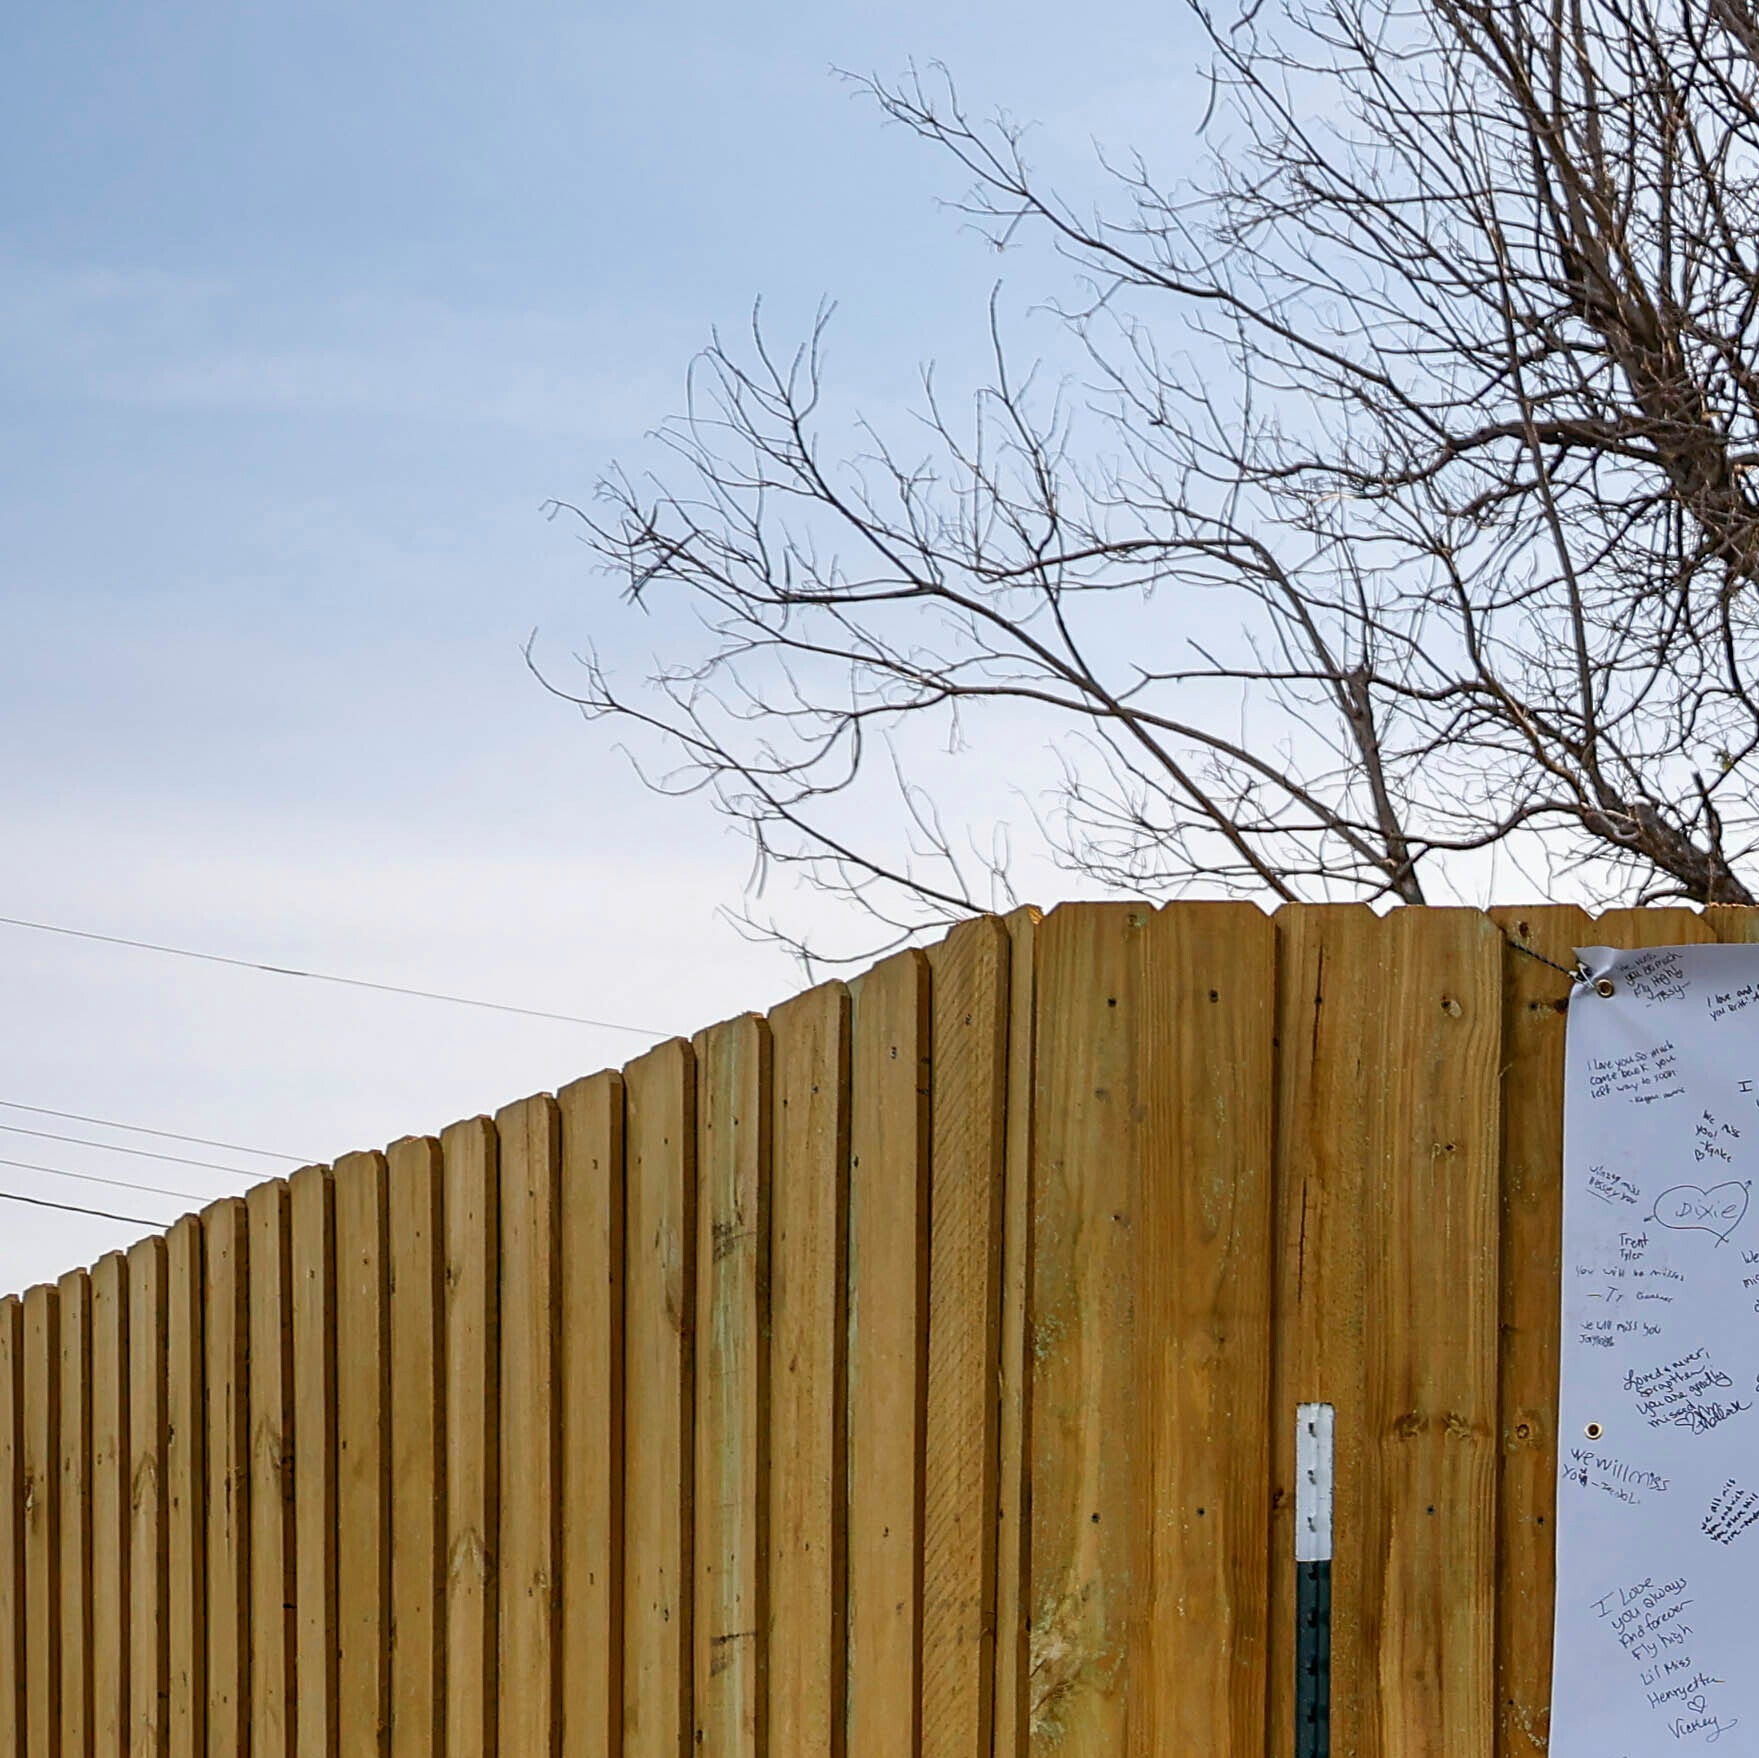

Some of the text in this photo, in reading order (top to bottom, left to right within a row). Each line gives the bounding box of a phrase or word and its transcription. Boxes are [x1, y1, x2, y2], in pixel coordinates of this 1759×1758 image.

[1738, 1080, 1752, 1092] I
[1676, 1203, 1737, 1220] Dixie
[1619, 1232, 1648, 1248] Trent
[1741, 1251, 1759, 1263] We
[1590, 1598, 1612, 1618] I
[1612, 1578, 1690, 1633] you always
[1643, 1598, 1693, 1639] forever
[1632, 1624, 1693, 1660] Fly high
[1664, 1657, 1691, 1675] Miss
